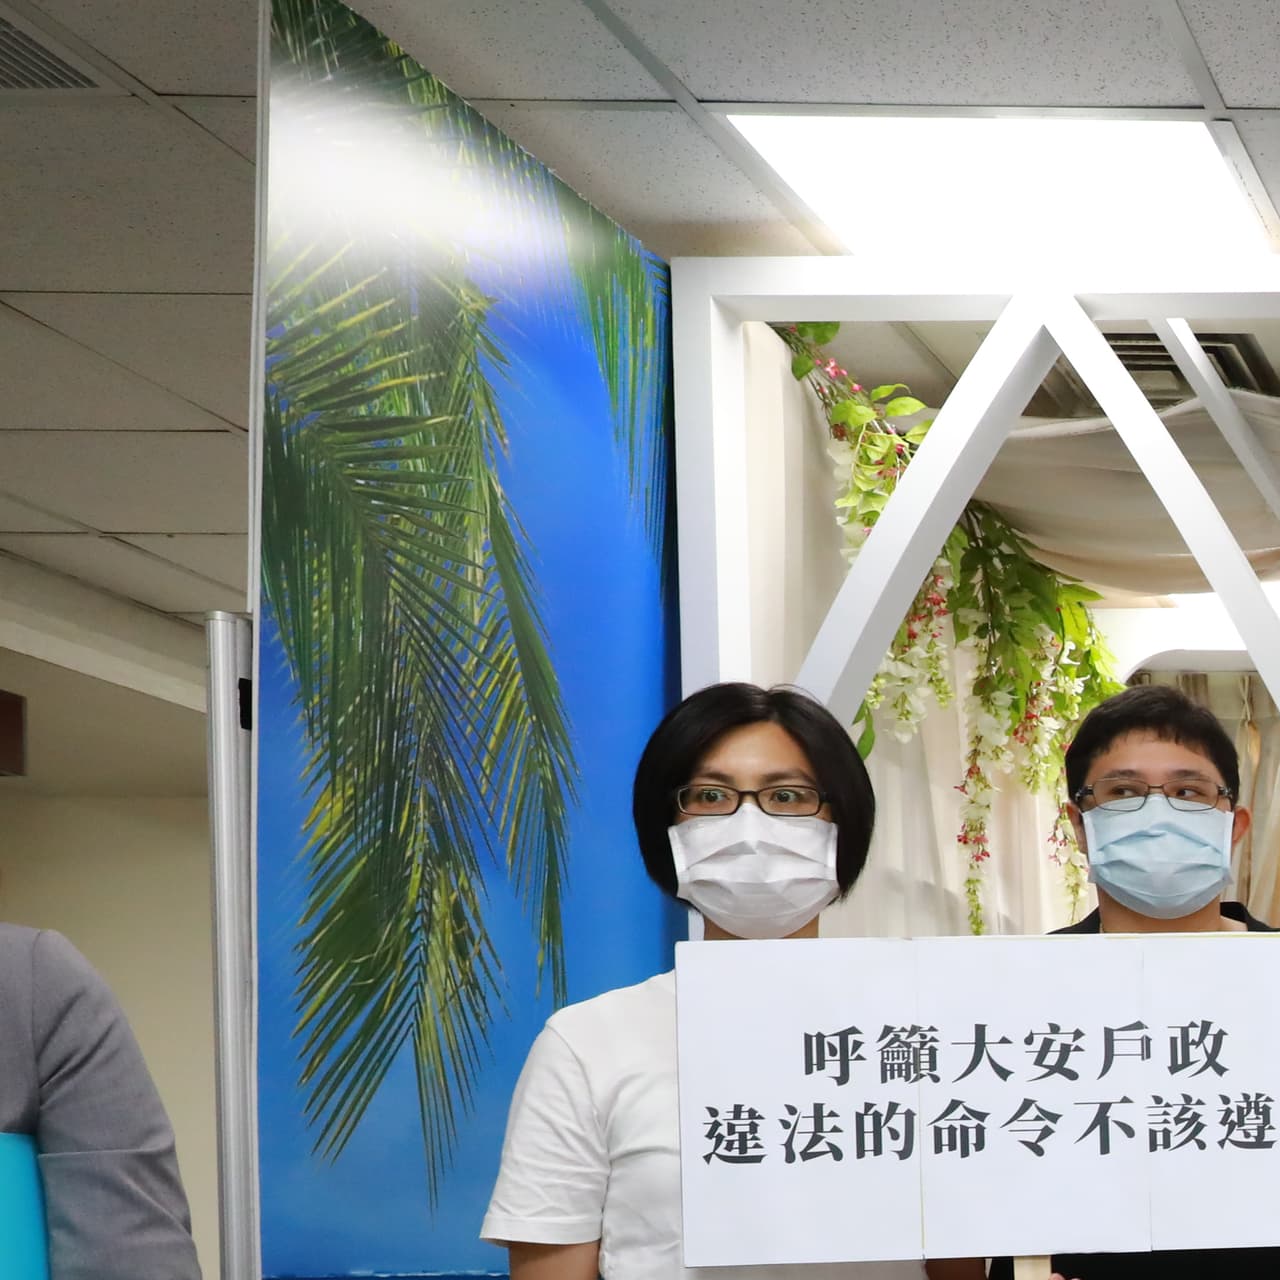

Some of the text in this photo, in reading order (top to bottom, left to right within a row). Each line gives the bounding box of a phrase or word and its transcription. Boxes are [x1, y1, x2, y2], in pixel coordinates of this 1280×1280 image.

[803, 1019, 1230, 1086] 呼籲大安戶政
